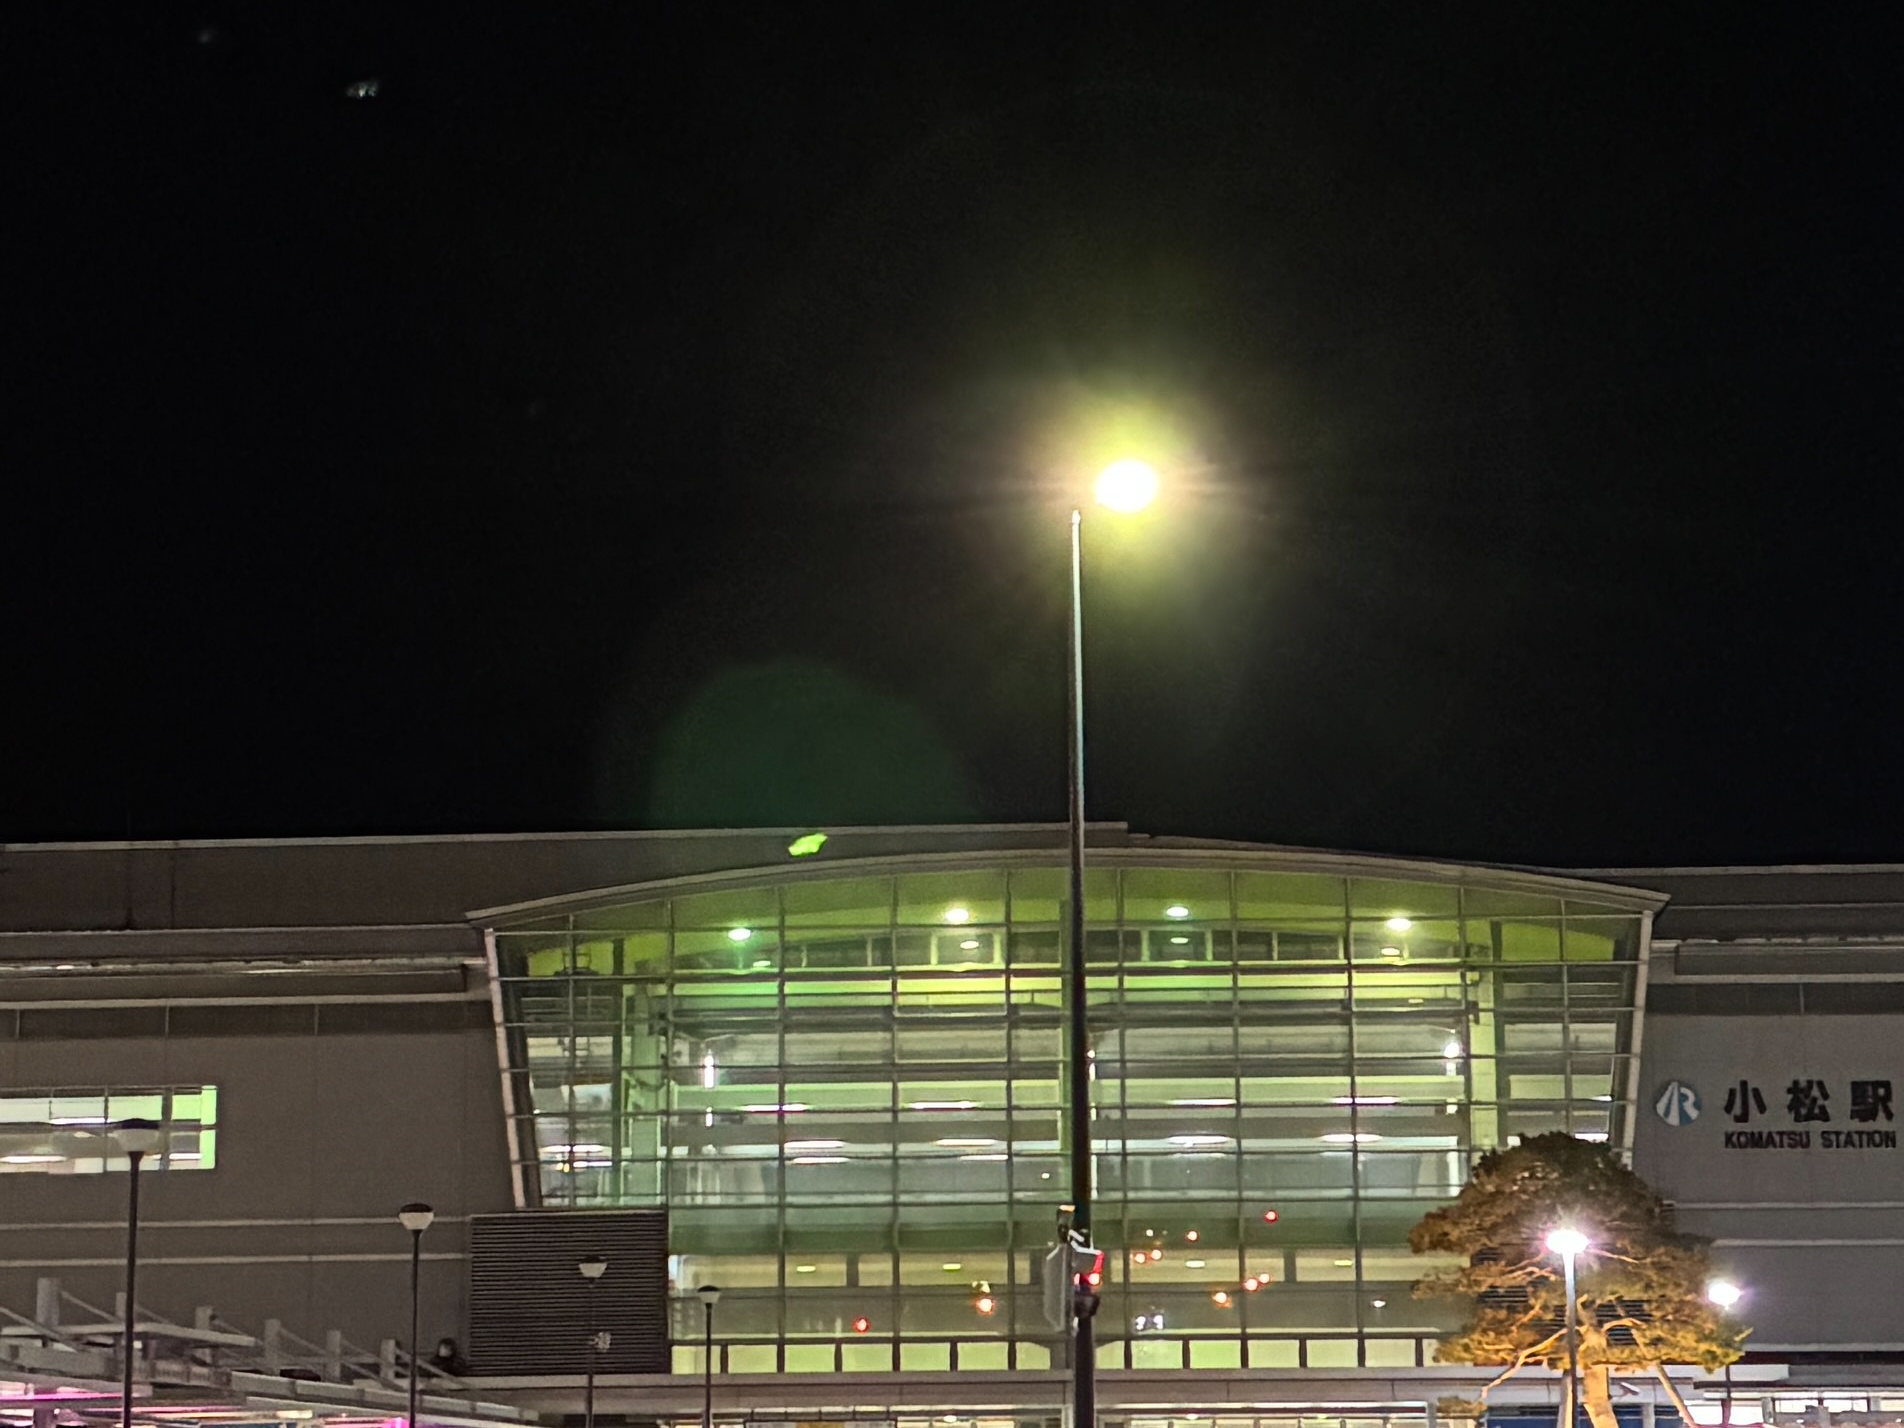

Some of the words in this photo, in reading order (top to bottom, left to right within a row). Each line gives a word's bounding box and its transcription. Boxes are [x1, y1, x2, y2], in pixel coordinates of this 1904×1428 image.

[1723, 1079, 1894, 1123] 小松駅
[1724, 1130, 1811, 1149] KOMATSU
[1821, 1130, 1897, 1149] STATION
